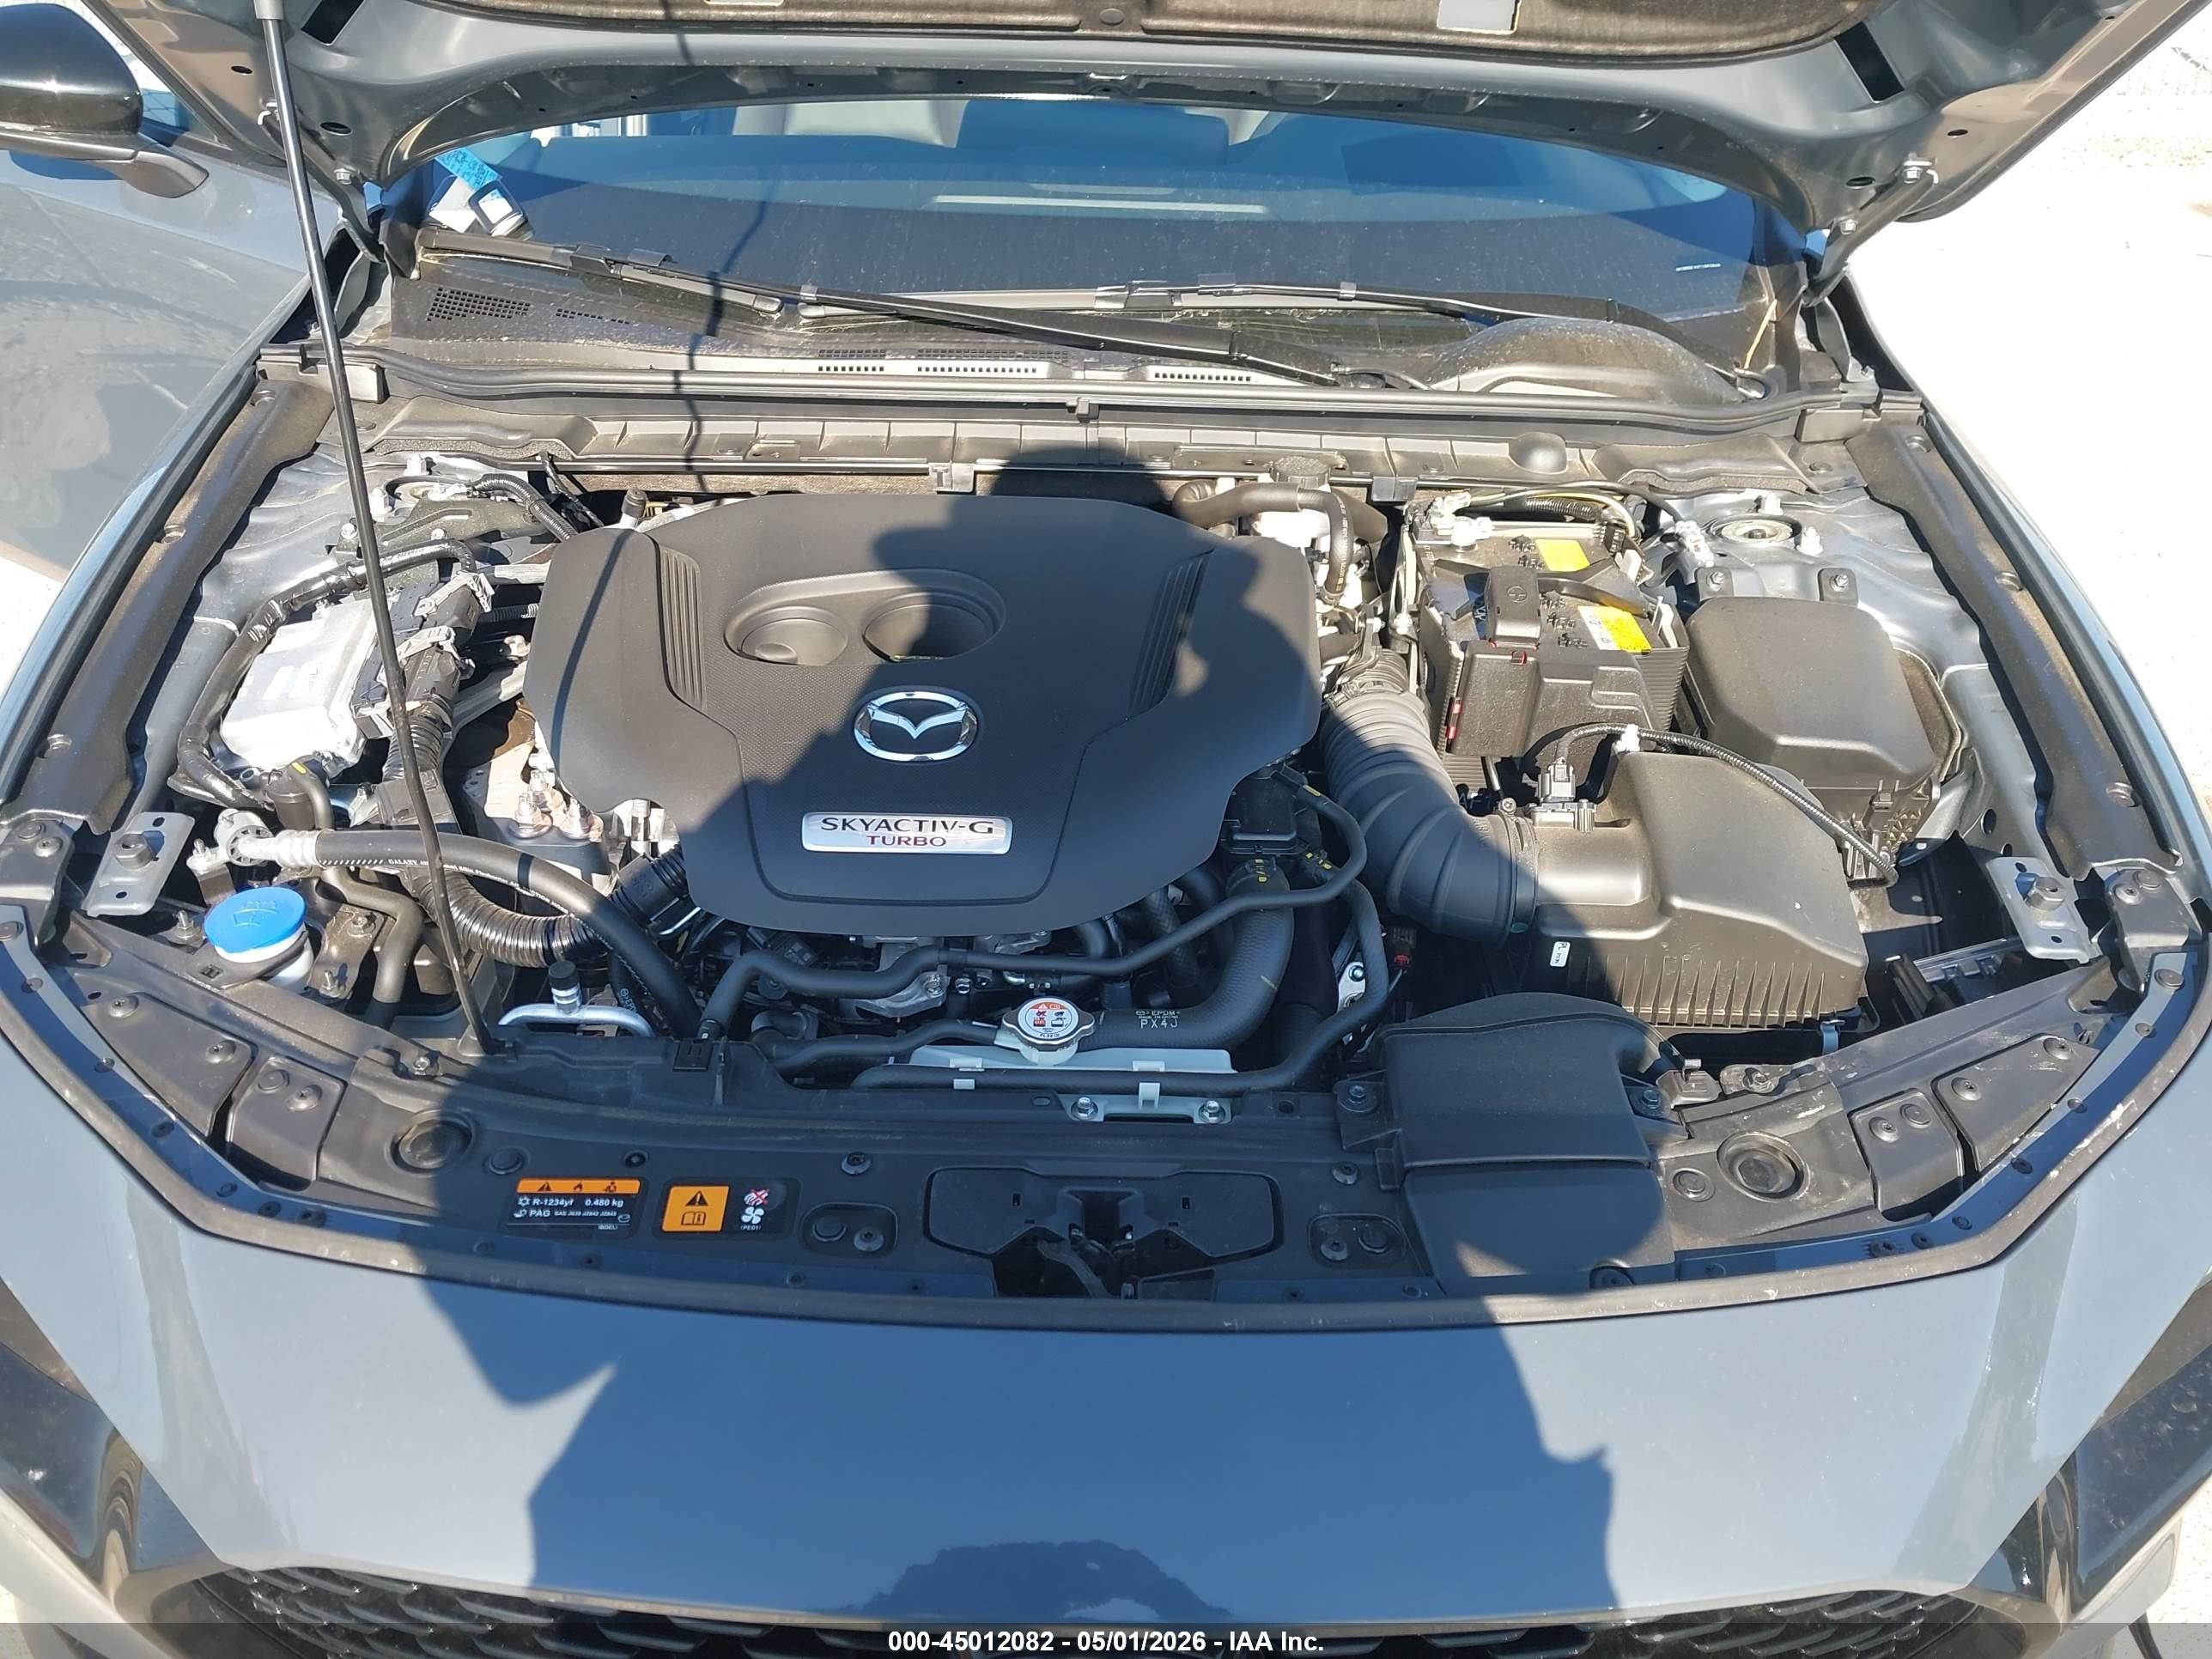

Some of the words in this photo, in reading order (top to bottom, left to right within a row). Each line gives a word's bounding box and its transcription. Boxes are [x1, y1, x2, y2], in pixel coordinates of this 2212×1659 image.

[820, 817, 994, 834] SKYACTIV-G
[866, 836, 946, 847] TURBO
[1140, 1018, 1178, 1030] PX4J
[532, 1199, 574, 1207] R-1234yf
[611, 1199, 623, 1208] kg
